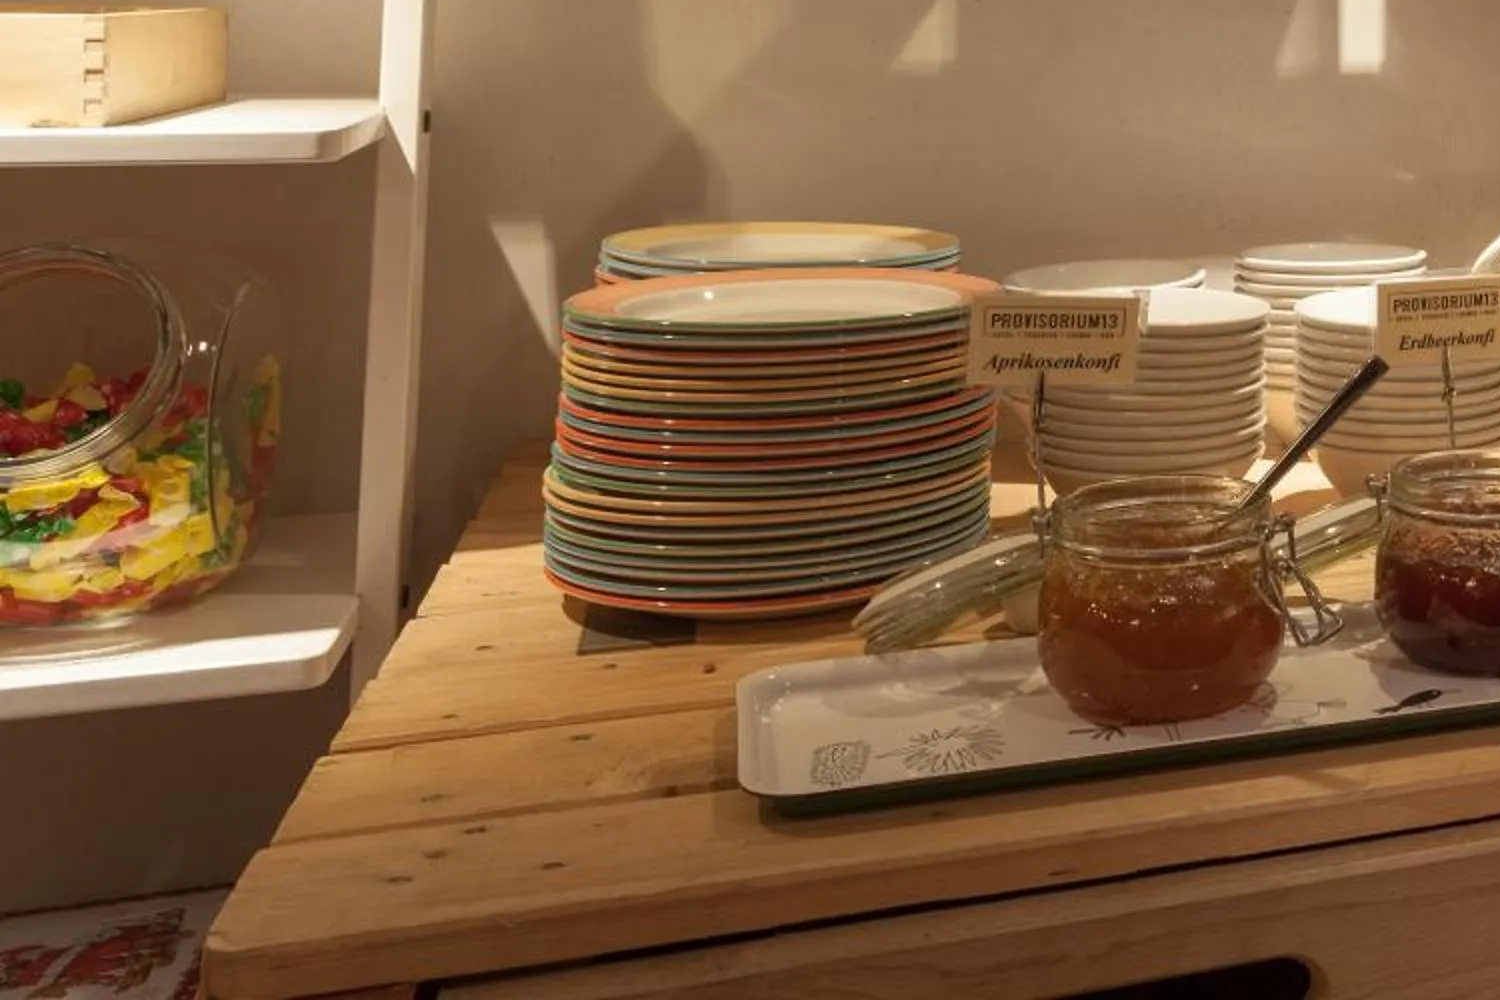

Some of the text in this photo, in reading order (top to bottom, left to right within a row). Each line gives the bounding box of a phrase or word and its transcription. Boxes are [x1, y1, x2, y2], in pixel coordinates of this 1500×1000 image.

[1393, 293, 1499, 313] PROVISORIUM13
[991, 313, 1118, 329] PROVISORIUM13
[1399, 328, 1495, 350] Erdbeerkonfi
[982, 353, 1122, 374] Aprikosenkonfi
